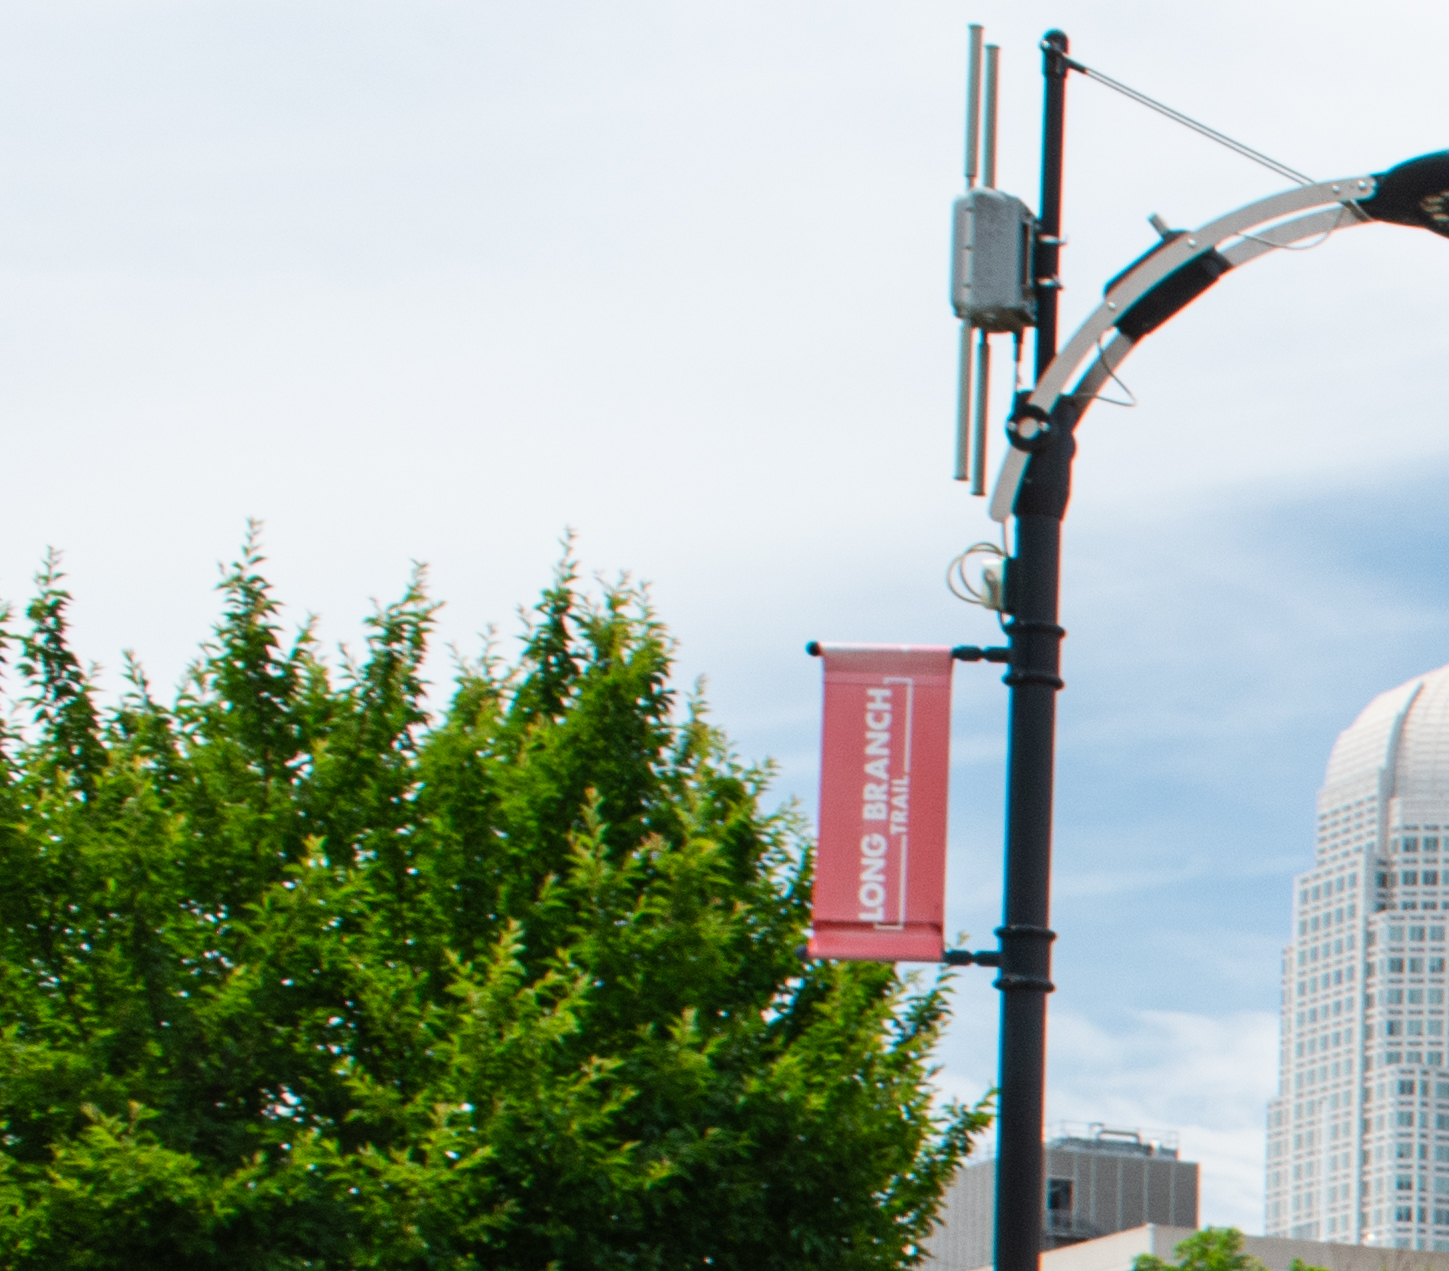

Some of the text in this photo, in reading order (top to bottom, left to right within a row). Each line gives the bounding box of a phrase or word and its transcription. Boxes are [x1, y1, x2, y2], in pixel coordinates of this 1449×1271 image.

[859, 688, 893, 922] LONG BRANCH
[890, 775, 910, 836] TRAIL
